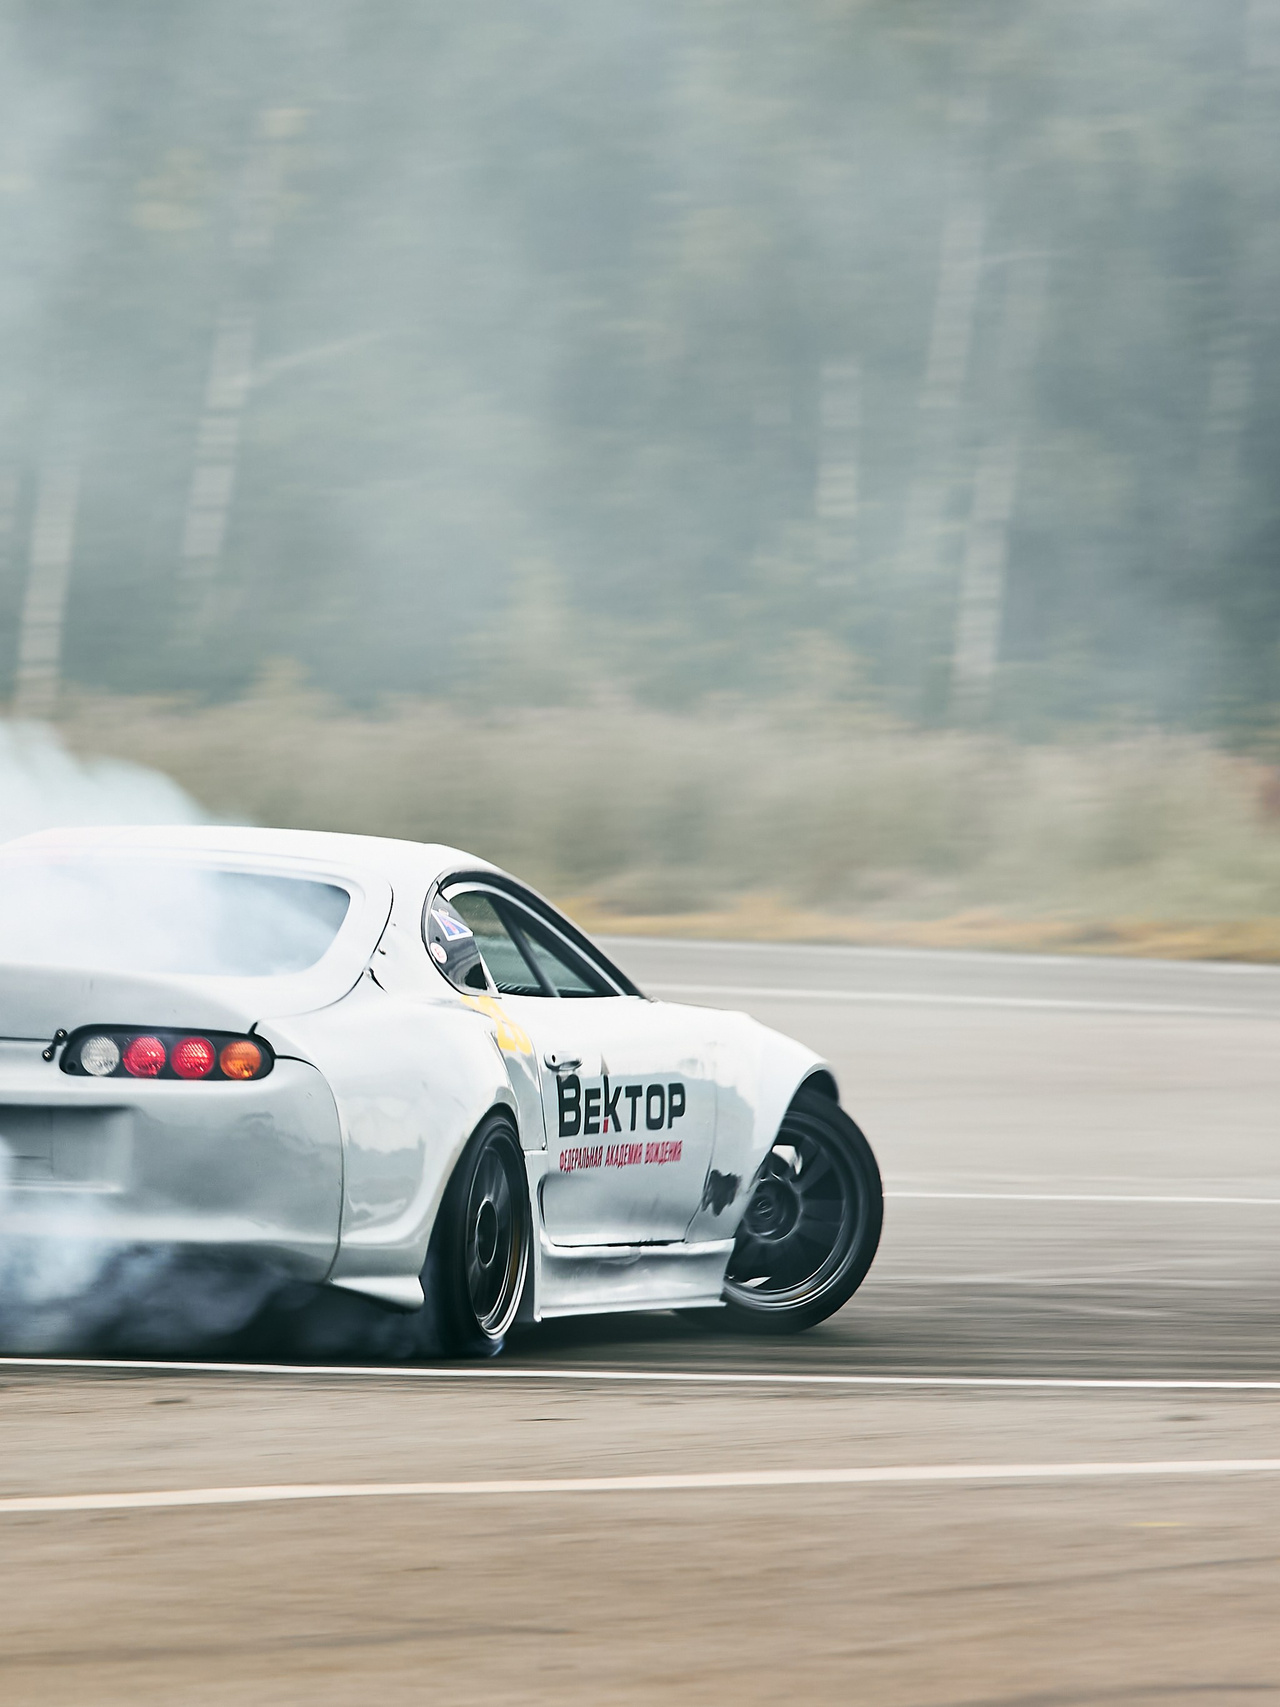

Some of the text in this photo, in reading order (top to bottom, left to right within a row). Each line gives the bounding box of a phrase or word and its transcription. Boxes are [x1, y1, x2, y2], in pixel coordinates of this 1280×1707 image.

[559, 1140, 683, 1173] ФЕДЕРАЛЬНАЯ АКАДЕМИЯ ВОЖДЕНИЯ
